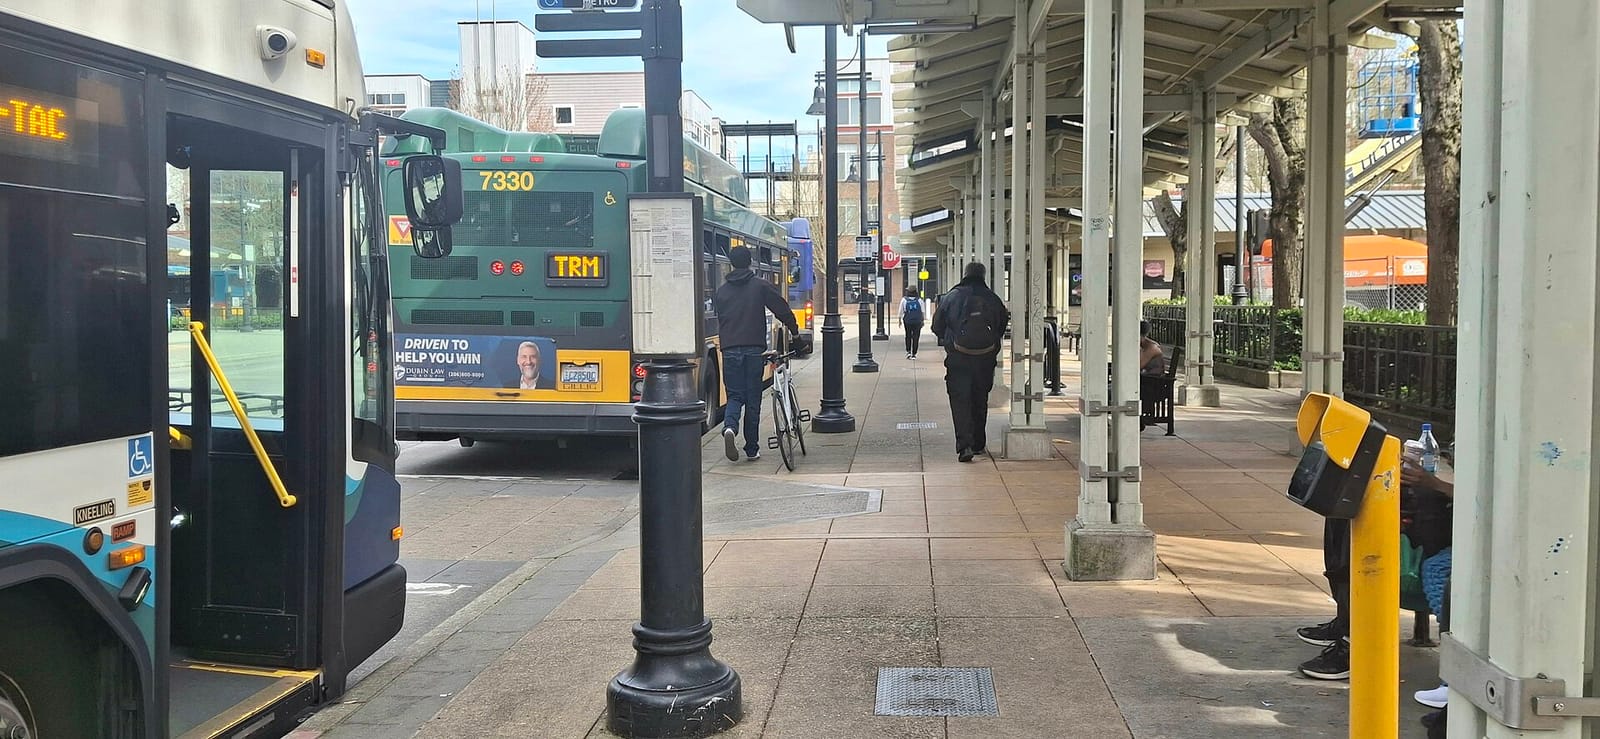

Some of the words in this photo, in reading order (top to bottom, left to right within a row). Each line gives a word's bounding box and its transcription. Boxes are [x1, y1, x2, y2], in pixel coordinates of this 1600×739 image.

[479, 170, 535, 192] 7330
[883, 251, 900, 262] TOP
[554, 255, 599, 278] TRM
[404, 338, 449, 350] DRIVEN
[451, 339, 469, 351] TO
[395, 351, 427, 363] HELP
[428, 353, 455, 364] YOU
[456, 353, 481, 365] WIN
[77, 502, 113, 523] KNEELING
[114, 523, 134, 539] RAMP
